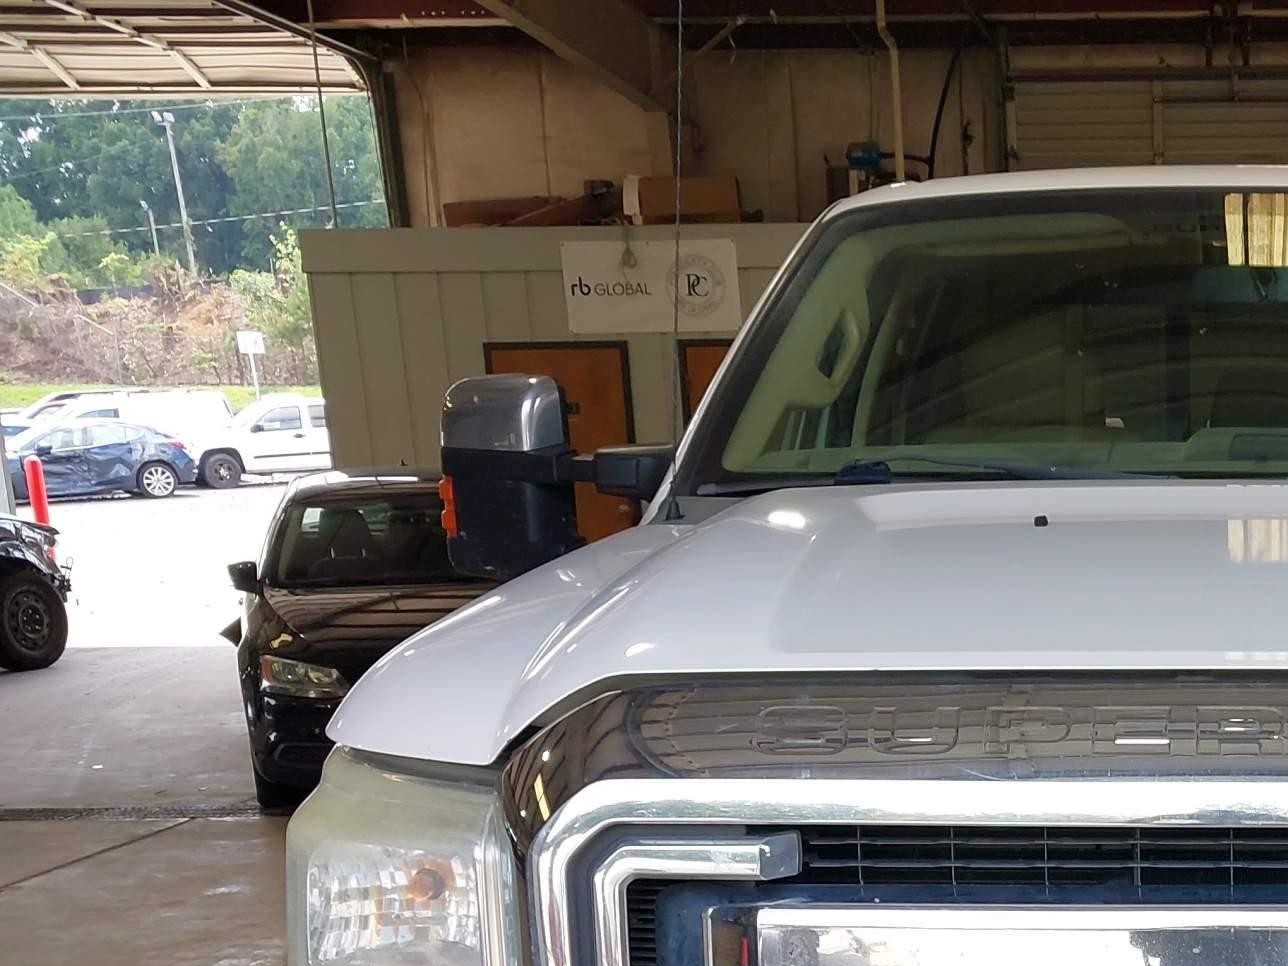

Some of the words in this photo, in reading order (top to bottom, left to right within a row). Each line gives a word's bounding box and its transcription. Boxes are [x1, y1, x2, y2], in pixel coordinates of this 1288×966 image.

[571, 276, 591, 296] rb
[594, 282, 652, 296] GLOBAL
[750, 705, 1286, 756] SUPER
